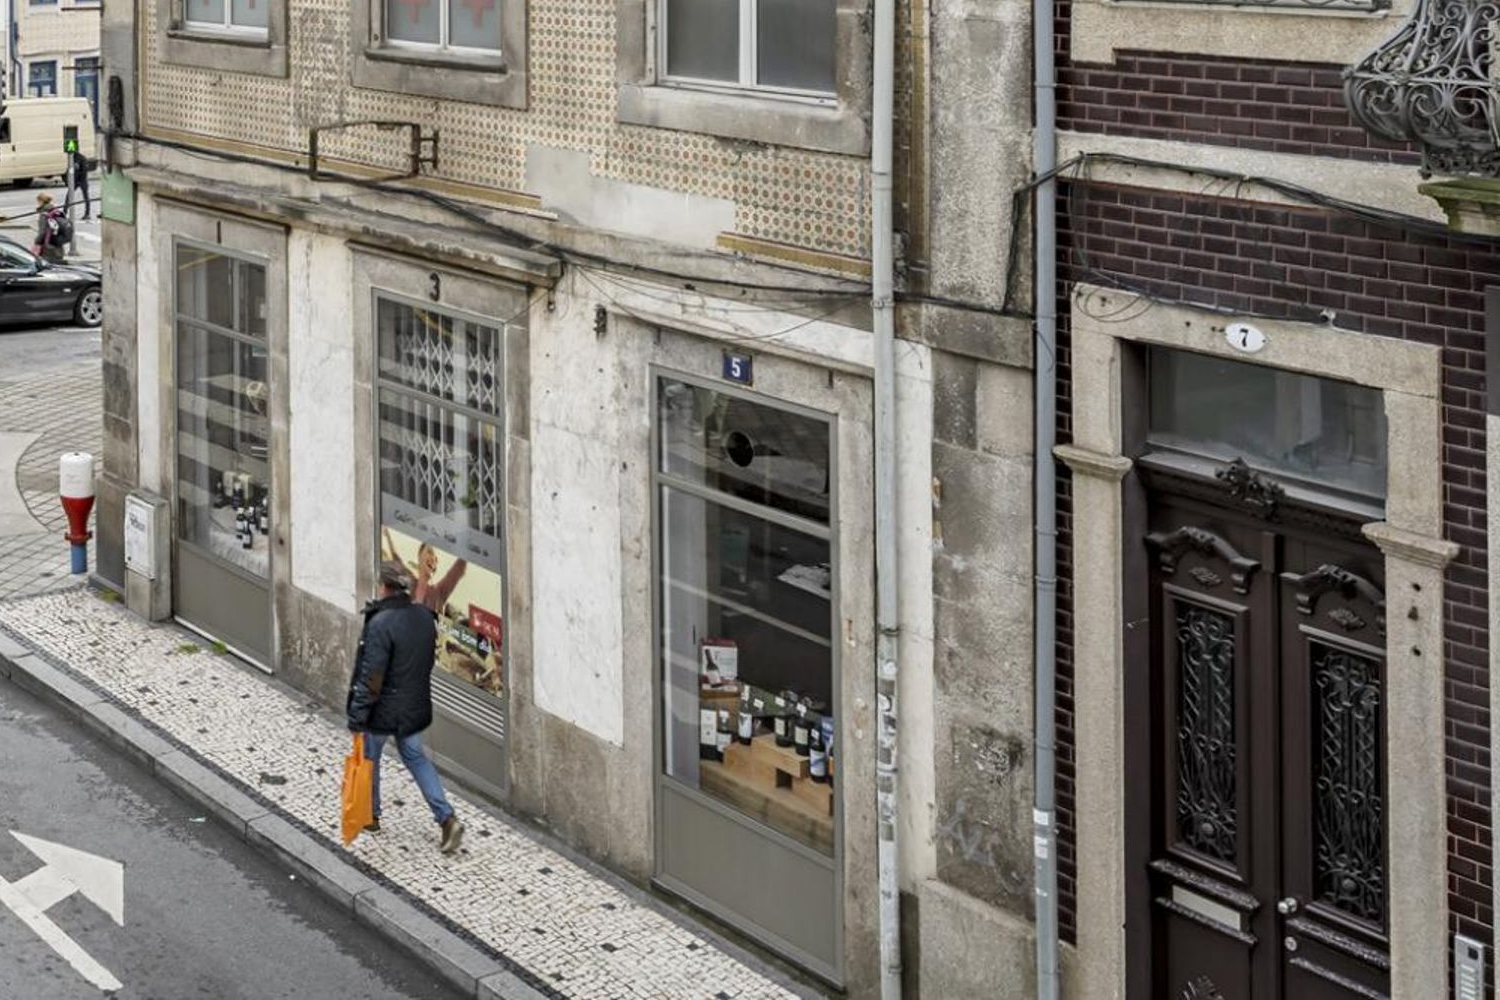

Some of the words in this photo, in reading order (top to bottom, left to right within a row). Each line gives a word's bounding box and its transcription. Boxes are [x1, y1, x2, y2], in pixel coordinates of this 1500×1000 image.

[429, 272, 441, 302] 3
[1240, 328, 1249, 347] 7
[731, 357, 741, 378] 5
